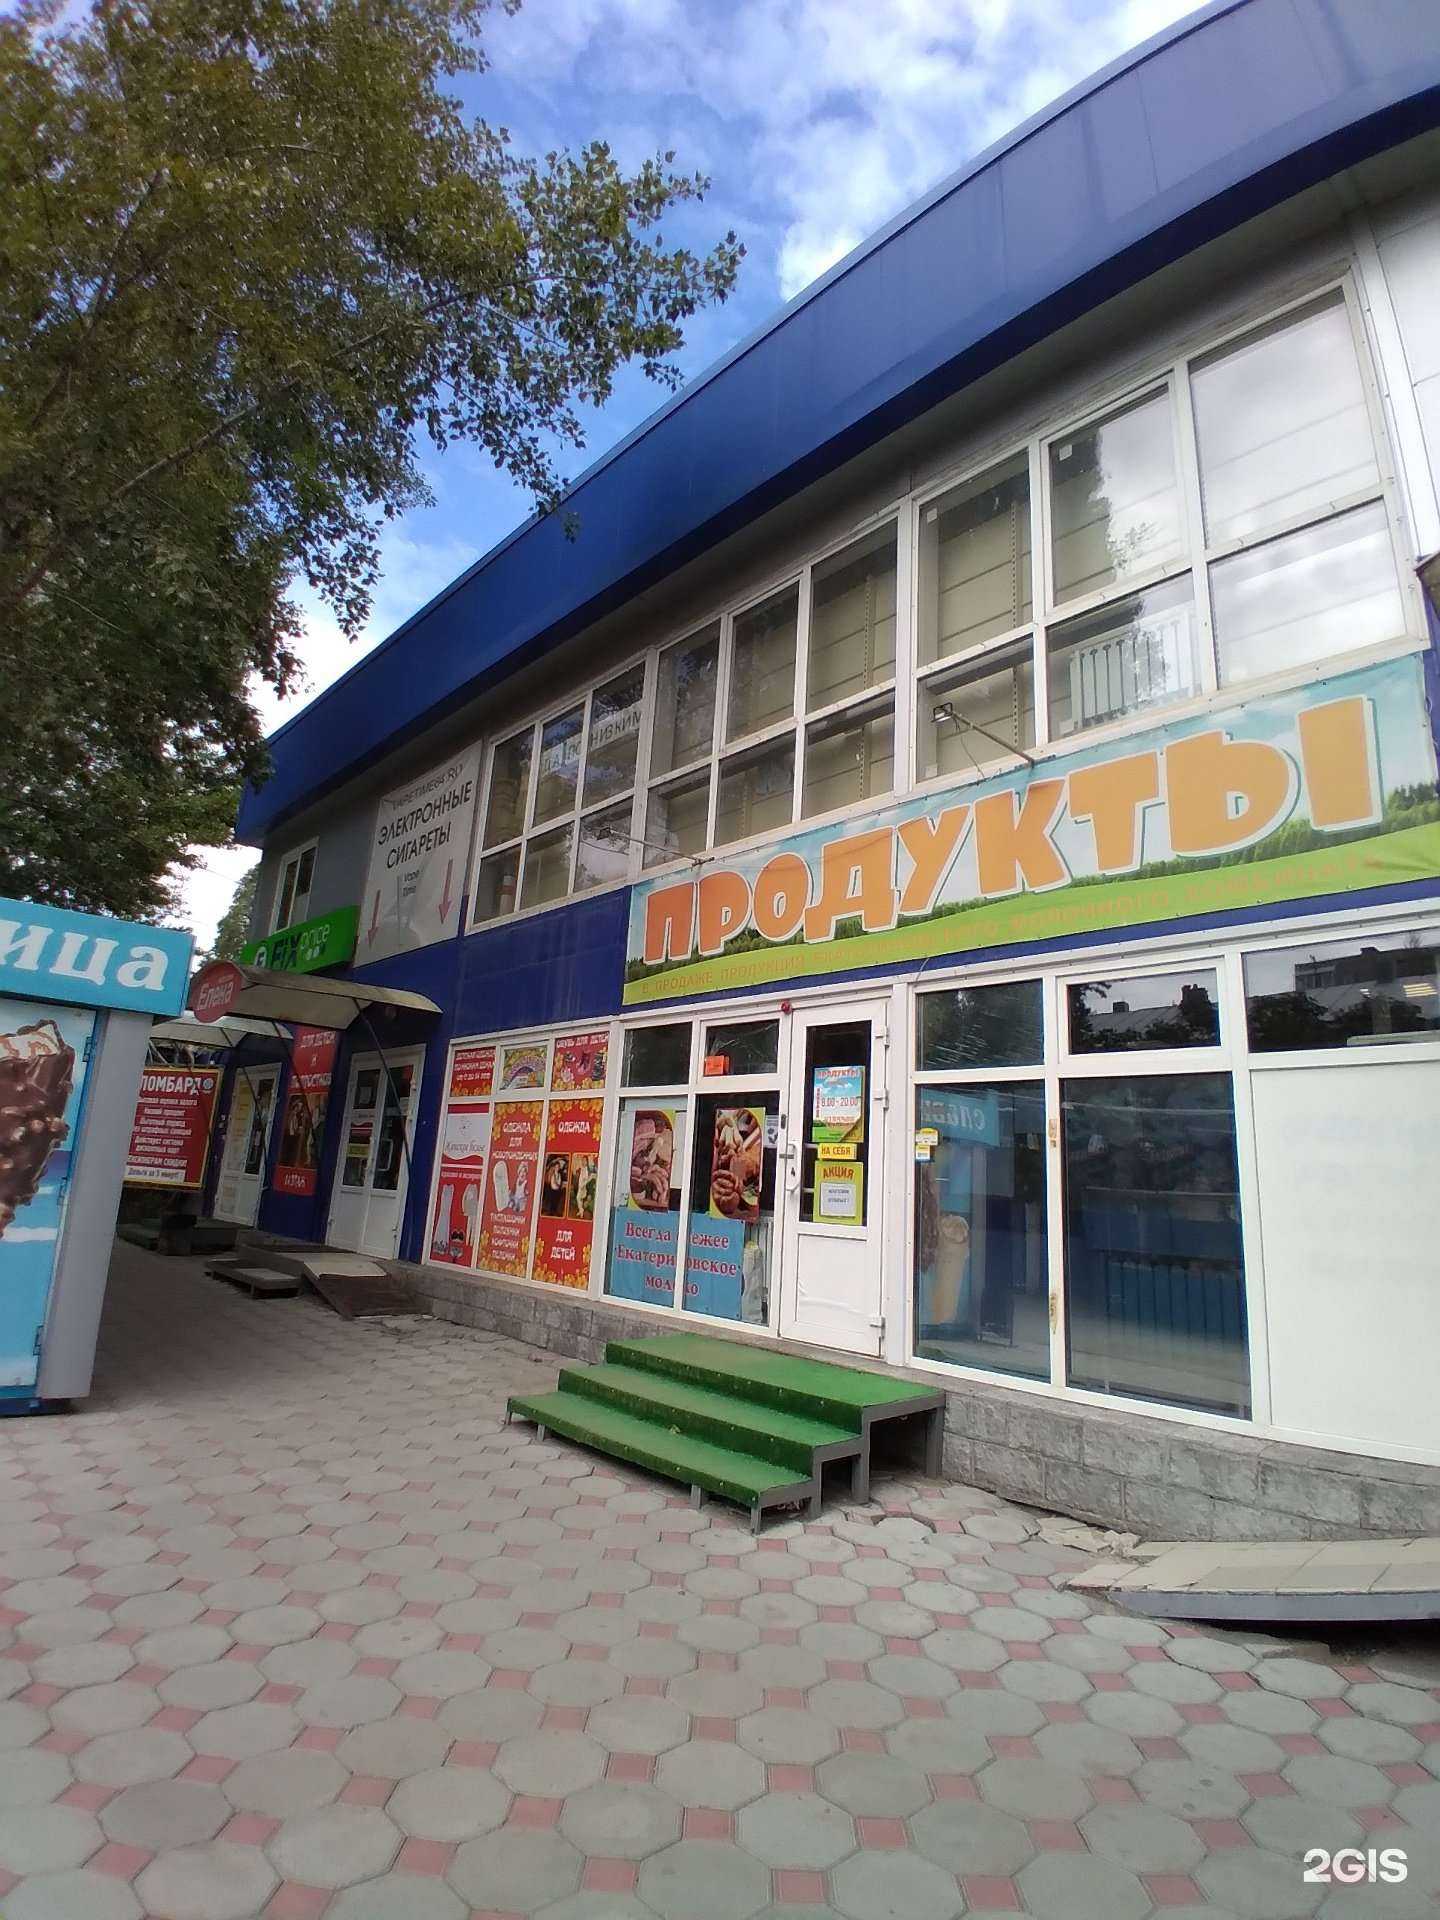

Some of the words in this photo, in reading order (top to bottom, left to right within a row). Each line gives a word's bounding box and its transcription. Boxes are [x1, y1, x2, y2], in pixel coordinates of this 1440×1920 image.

[378, 781, 473, 845] ЭЛЕКТРОННЫЕ
[643, 696, 1384, 965] ПРОДУКТЫ
[387, 822, 451, 869] СИГАРЕТЫ
[656, 972, 712, 992] ПРОДАЖЕ
[504, 1122, 531, 1134] ОДЕЖДА
[558, 1121, 591, 1135] ОДЕЖДА
[509, 1137, 523, 1147] ДЛЯ
[821, 1146, 831, 1155] НА
[832, 1146, 851, 1156] СЕБЯ
[823, 1166, 855, 1180] АКЦИЯ
[555, 1230, 573, 1242] ДЛЯ
[625, 1221, 671, 1242] Всегда
[677, 1231, 730, 1249] ежее
[551, 1246, 576, 1261] ДЕТЕЙ
[645, 1274, 700, 1297] молко
